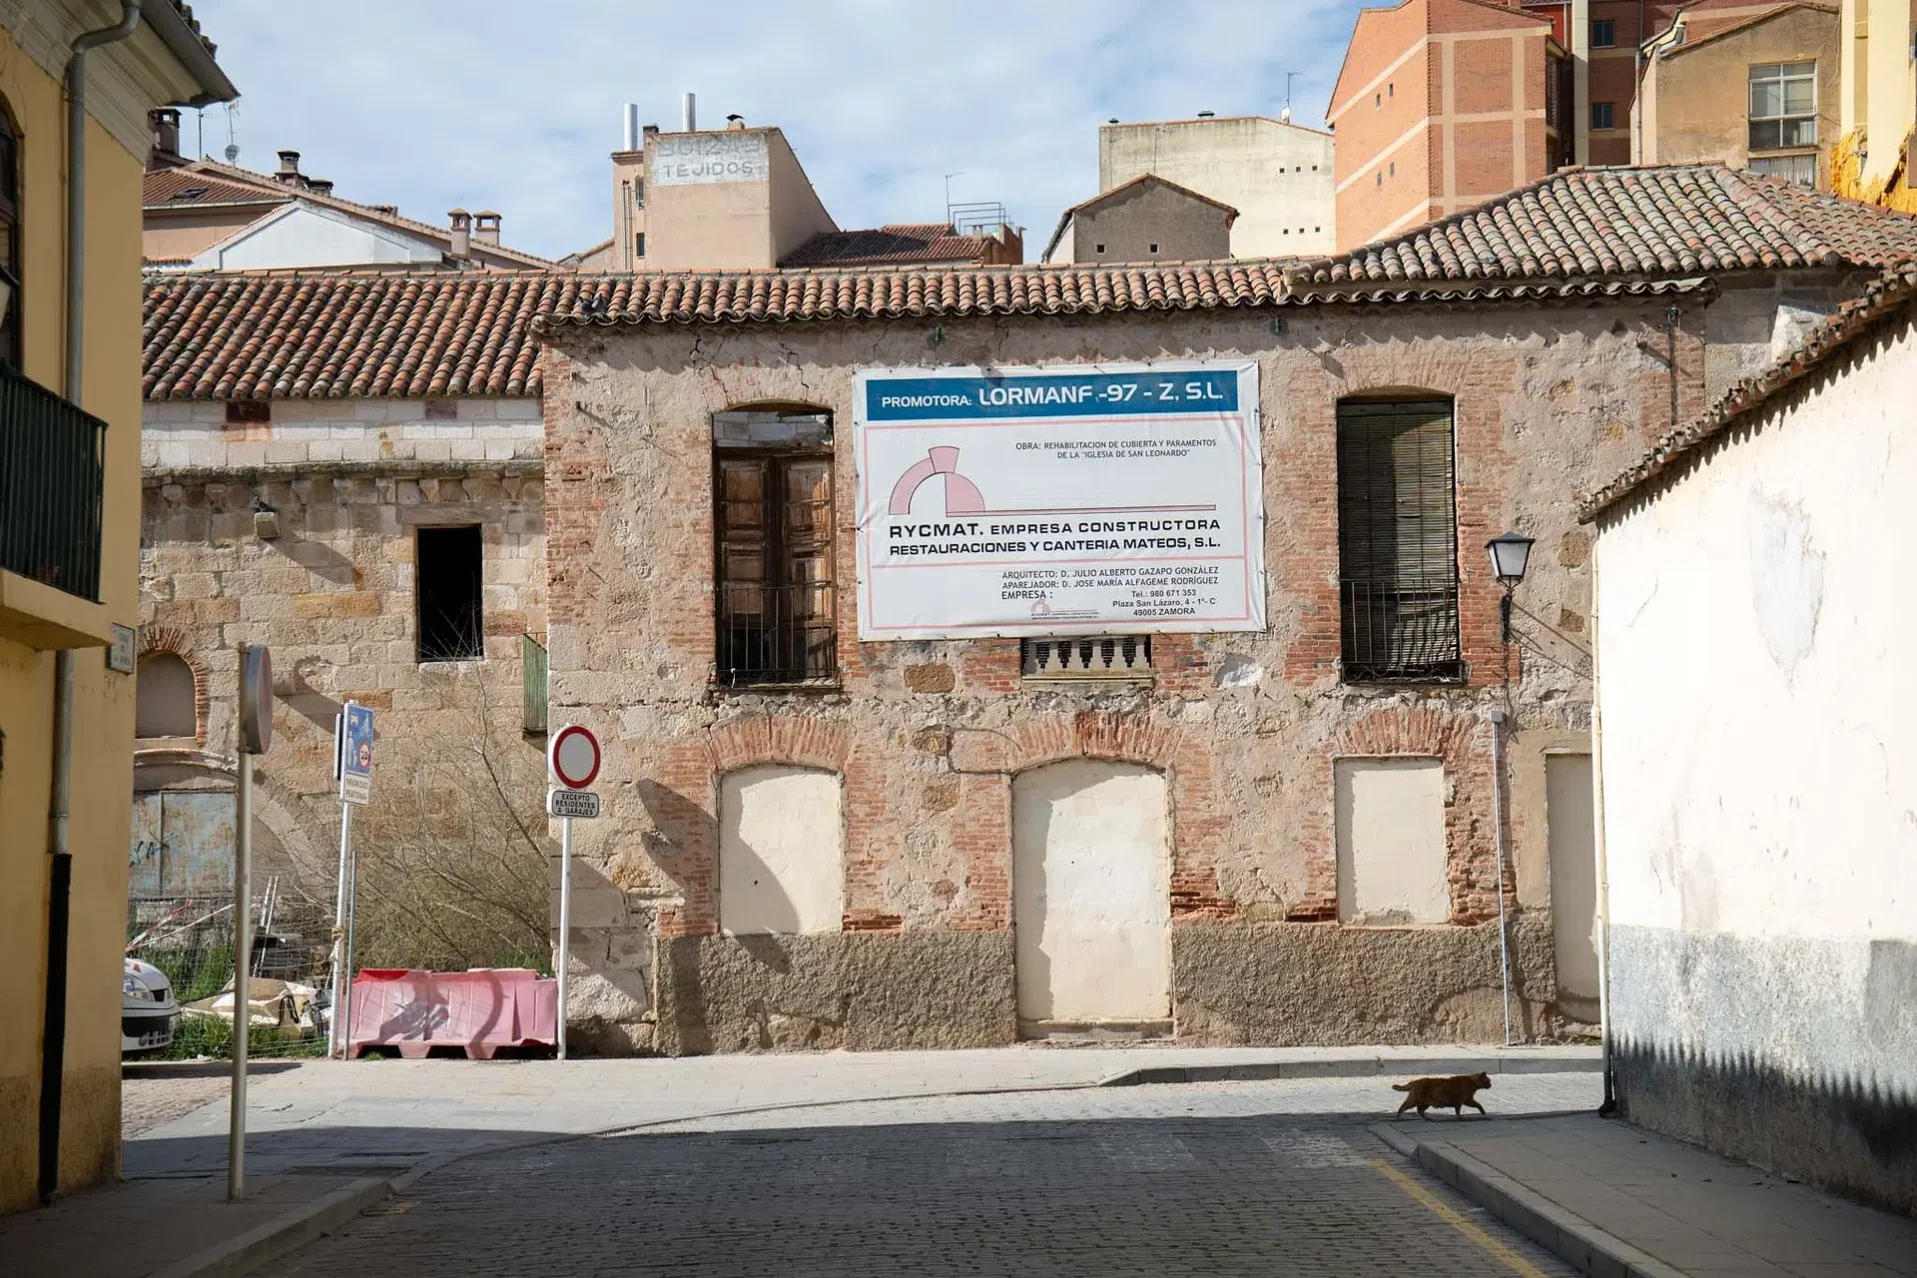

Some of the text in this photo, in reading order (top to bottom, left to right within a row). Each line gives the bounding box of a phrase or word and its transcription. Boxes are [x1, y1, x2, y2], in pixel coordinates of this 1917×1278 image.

[662, 160, 753, 178] TEJIDOS
[881, 395, 972, 408] PROMOTORA:
[978, 386, 1093, 406] LORMANF
[1158, 383, 1180, 402] Z,
[1186, 381, 1224, 400] S.L.
[1015, 442, 1042, 450] OBRA:
[1044, 441, 1106, 450] REHABILITACION
[1108, 441, 1119, 449] DE
[1120, 440, 1158, 448] CUBIERTA
[1166, 439, 1217, 447] PARAMENTOS
[1057, 451, 1068, 459] DE
[1069, 451, 1080, 459] LA
[1116, 450, 1126, 458] DE
[1128, 450, 1144, 458] SAN
[890, 519, 1220, 538] RYCMAT. EMPRESA CONSTRUCTORA
[889, 537, 1220, 556] RESTAURACIONES Y CANTERIA MATEOS, S.L.
[1002, 566, 1219, 579] ARQUITECTO: D. JULIO ALBERTO GAZAPO GONZÁLEZ
[1002, 576, 1219, 589] APAREJADOR: D. JOSE MARÍA ALFAGEME RODRÍGUEZ
[1001, 591, 1047, 600] EMPRESA
[1149, 589, 1164, 597] 980
[1166, 589, 1180, 597] 671
[1112, 600, 1134, 608] Plaza
[1136, 599, 1151, 607] San
[1153, 599, 1183, 608] Lázaro,
[1209, 597, 1216, 605] C
[1158, 607, 1195, 616] ZAMORA
[561, 793, 591, 802] EXCEPTO
[555, 799, 595, 809] RESIDENTES
[565, 807, 594, 816] GARAJES
